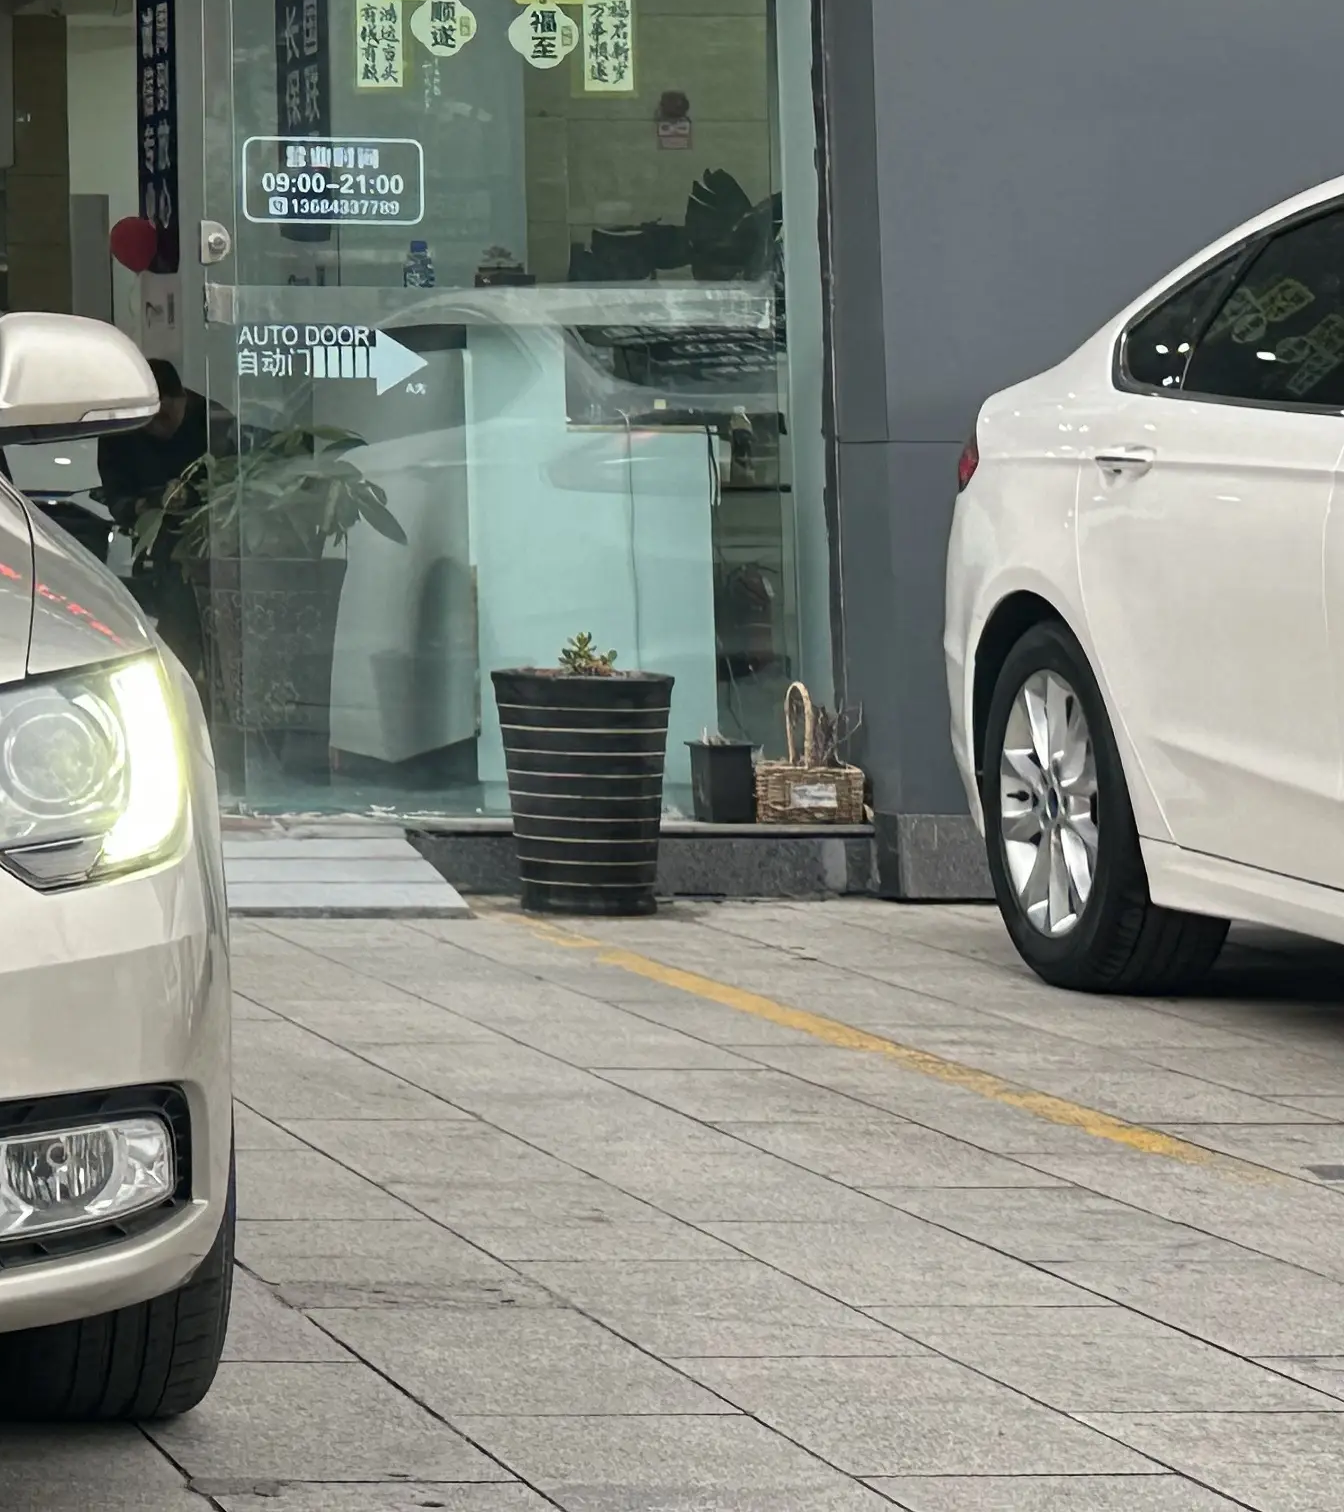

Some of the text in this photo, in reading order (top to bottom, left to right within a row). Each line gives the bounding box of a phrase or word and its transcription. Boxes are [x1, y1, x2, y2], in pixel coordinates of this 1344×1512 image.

[530, 10, 558, 59] 福至
[262, 172, 404, 194] 09:00-21:00
[238, 325, 371, 346] AUTO DOOR
[238, 348, 311, 377] 自动门
